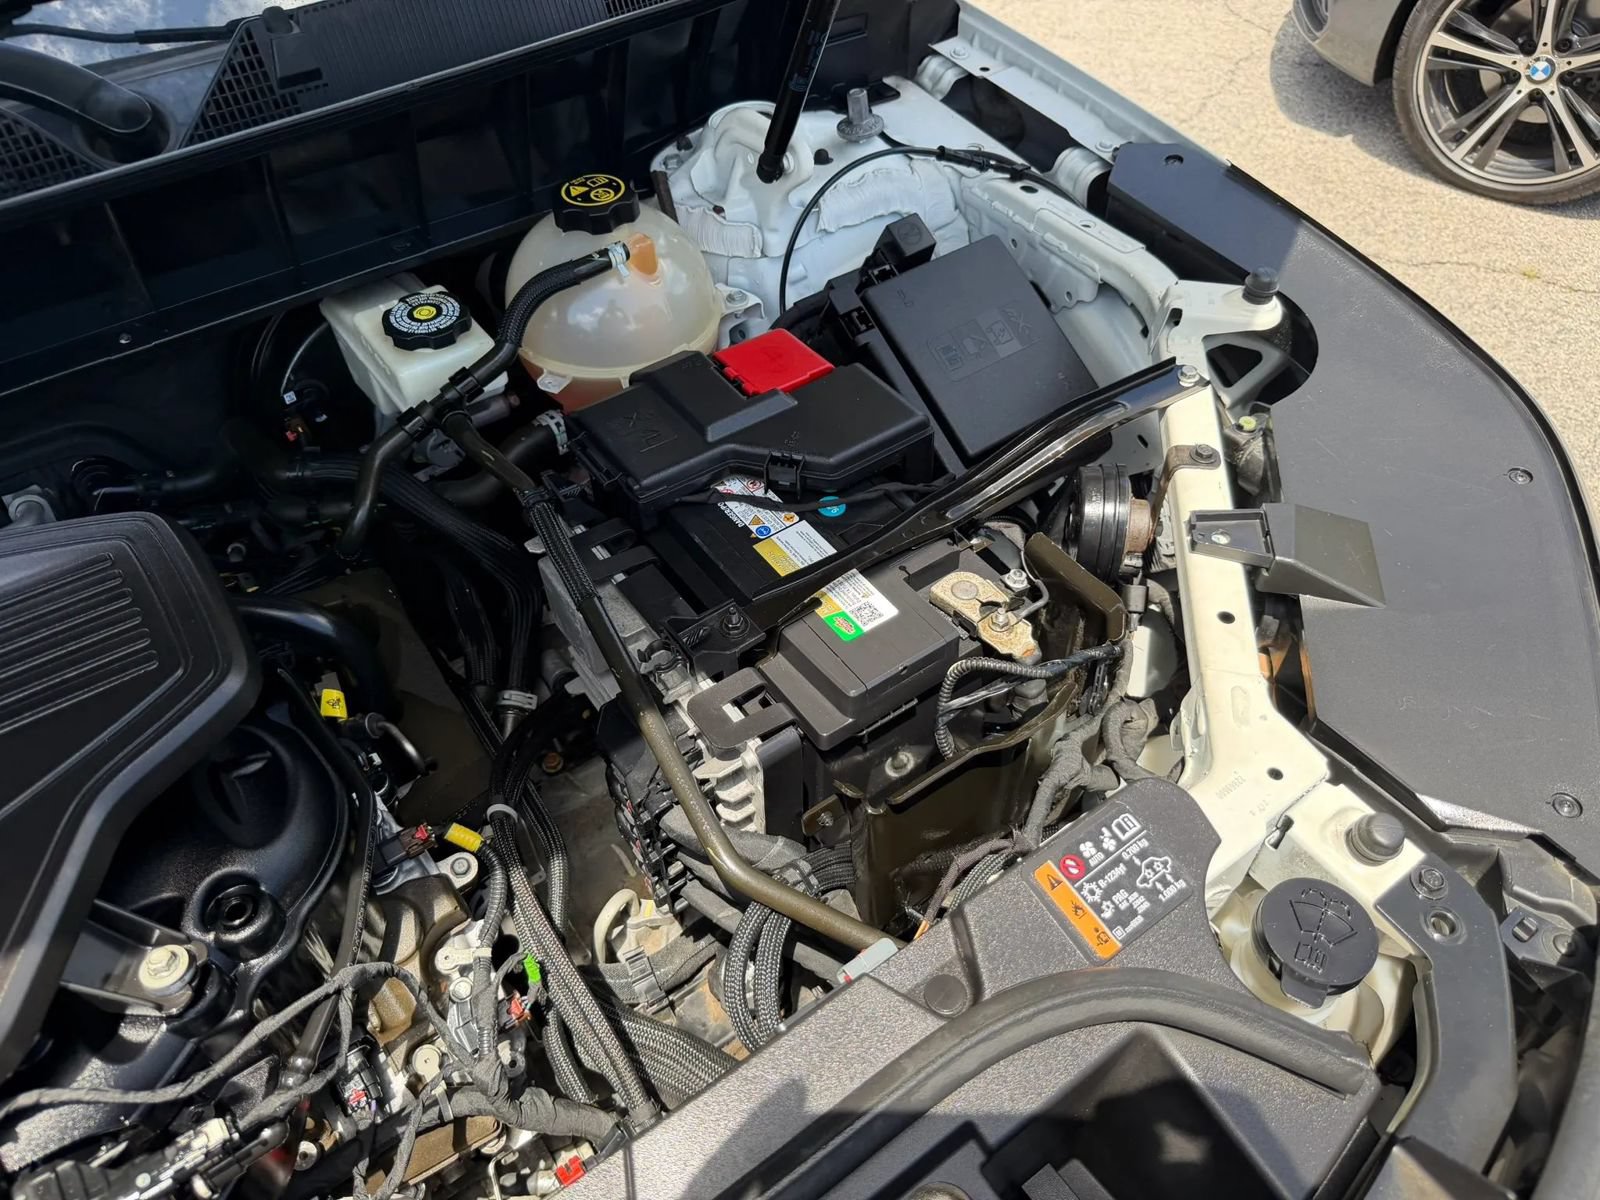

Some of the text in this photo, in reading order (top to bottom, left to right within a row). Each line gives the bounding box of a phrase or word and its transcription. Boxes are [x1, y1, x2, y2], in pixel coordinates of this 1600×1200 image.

[717, 502, 745, 528] DANGER/PO
[1089, 852, 1105, 867] AUTO
[1098, 863, 1127, 888] R-1234yf
[1112, 889, 1129, 905] PAG
